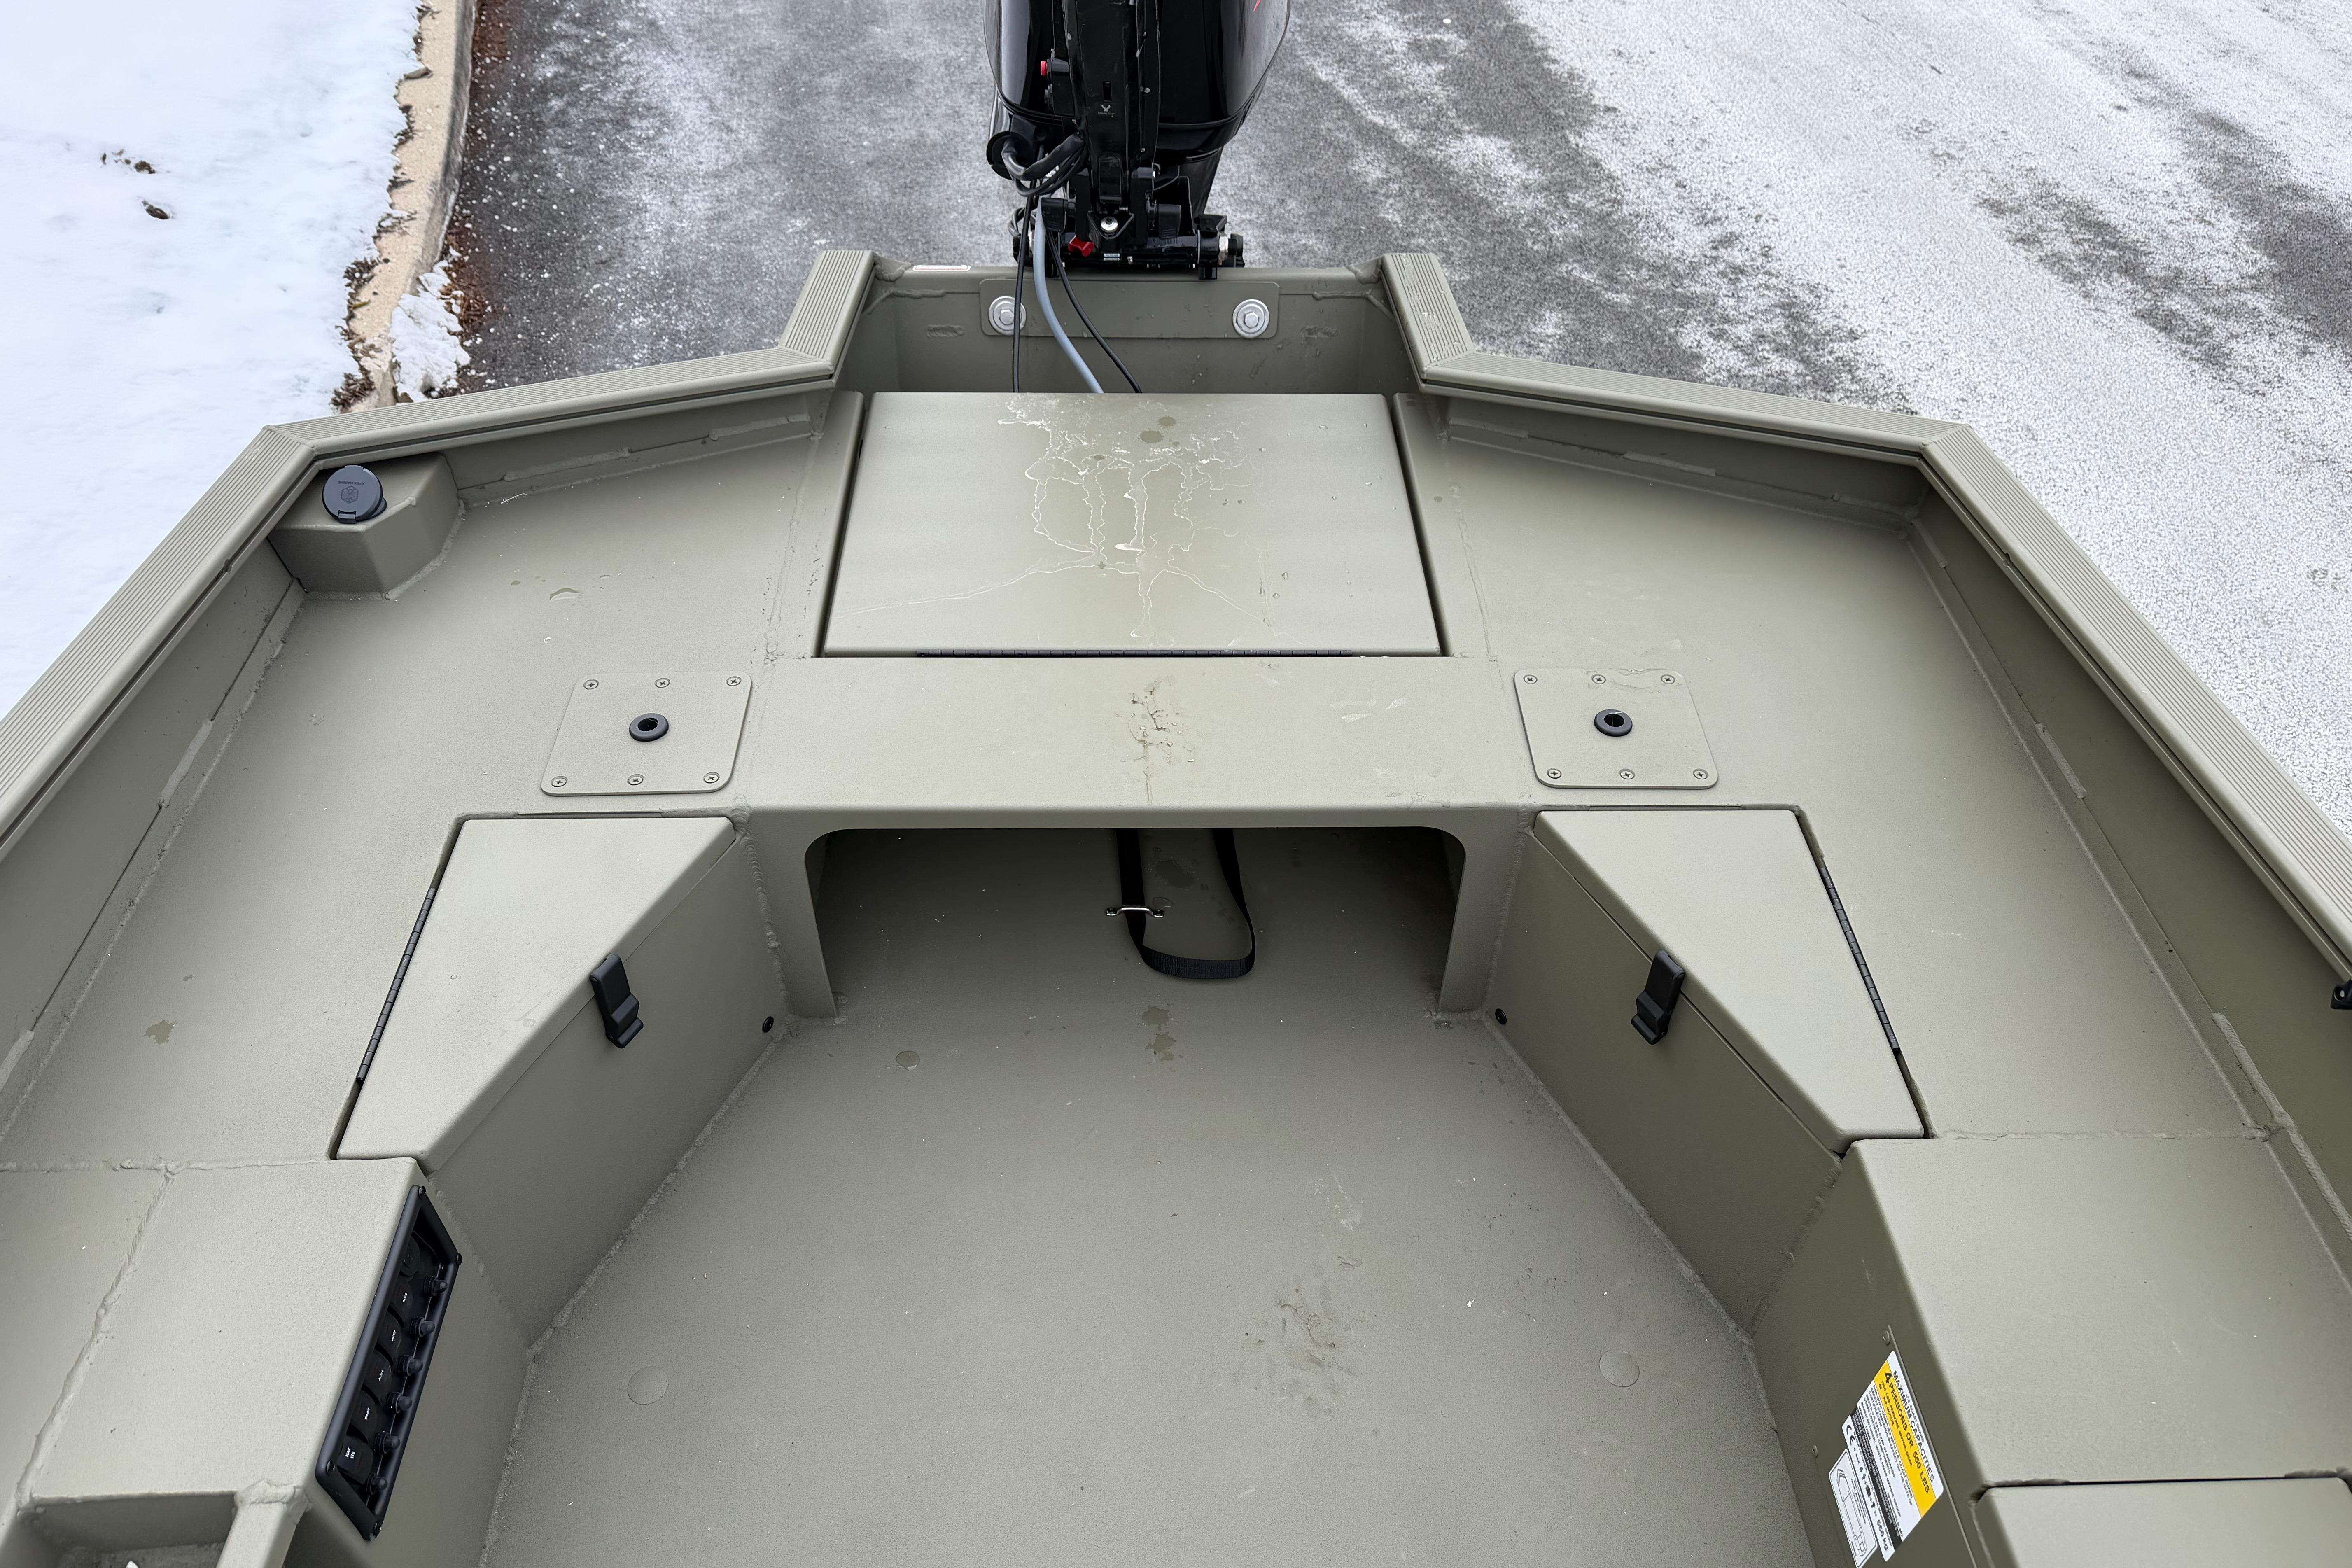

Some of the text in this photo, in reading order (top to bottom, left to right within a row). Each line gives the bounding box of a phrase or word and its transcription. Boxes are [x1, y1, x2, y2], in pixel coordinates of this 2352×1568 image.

[1885, 1373, 1892, 1384] 4
[1889, 1382, 1907, 1431] PERSONS
[1906, 1432, 1913, 1449] OR
[1920, 1471, 1930, 1493] LBS
[1893, 1370, 1934, 1482] MAXIMUM CAPACITIES
[1883, 1537, 1888, 1551] kg
